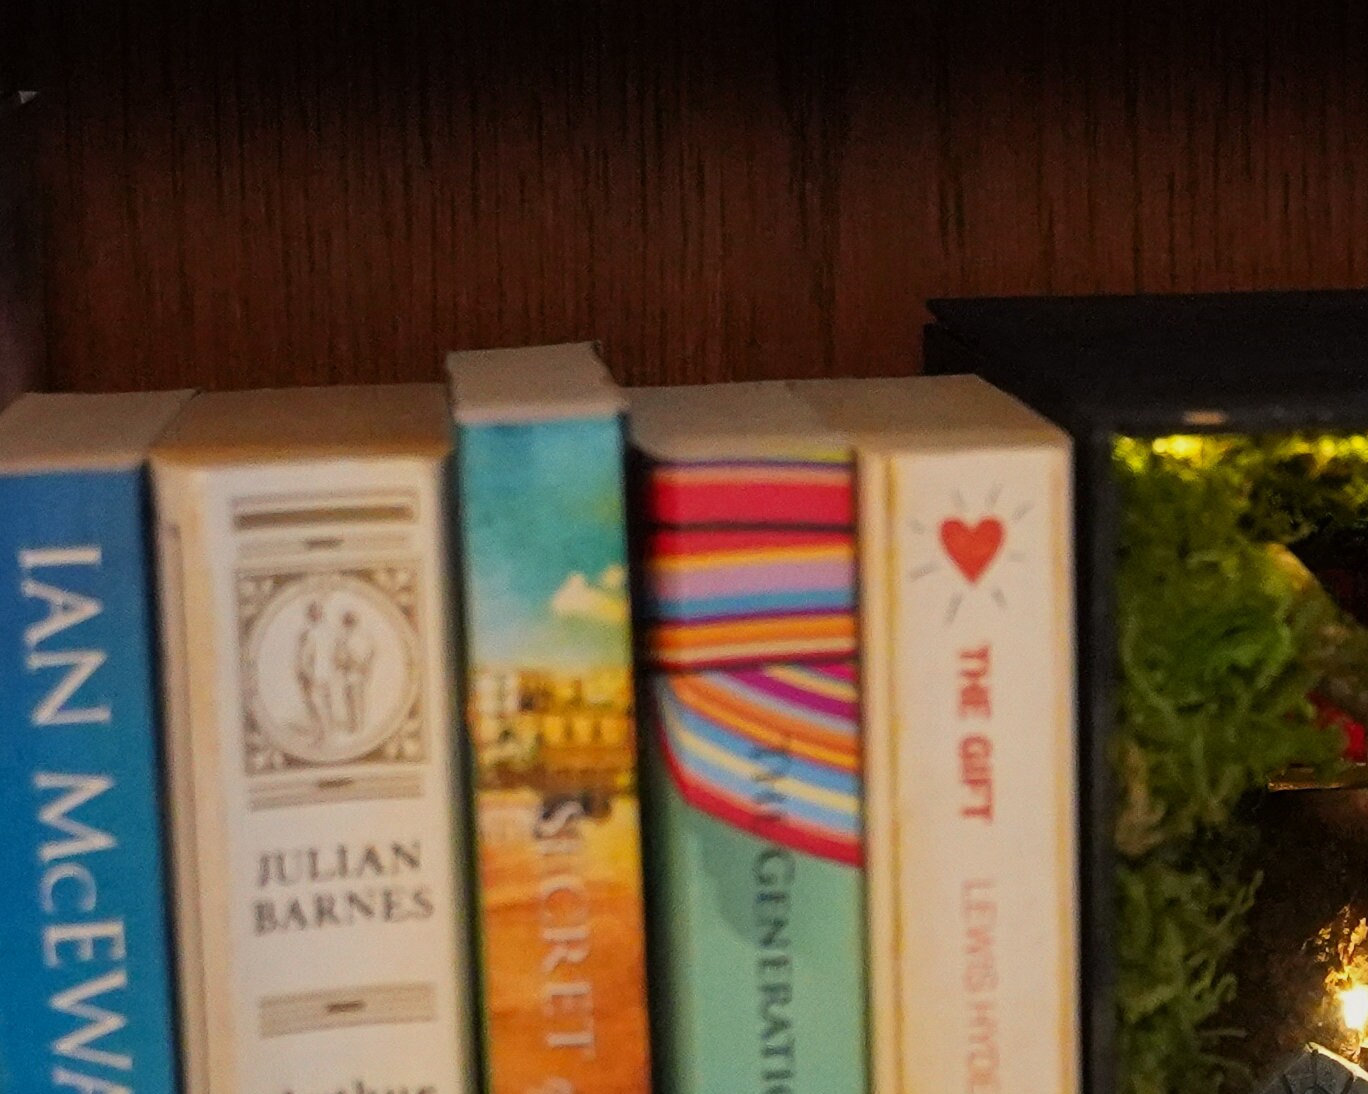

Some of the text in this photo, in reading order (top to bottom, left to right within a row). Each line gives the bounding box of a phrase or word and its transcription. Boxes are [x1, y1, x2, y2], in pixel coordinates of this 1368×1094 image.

[17, 545, 111, 727] IAN
[957, 645, 993, 824] THE GIFT
[254, 882, 436, 937] BARNES
[257, 838, 423, 889] JULIAN
